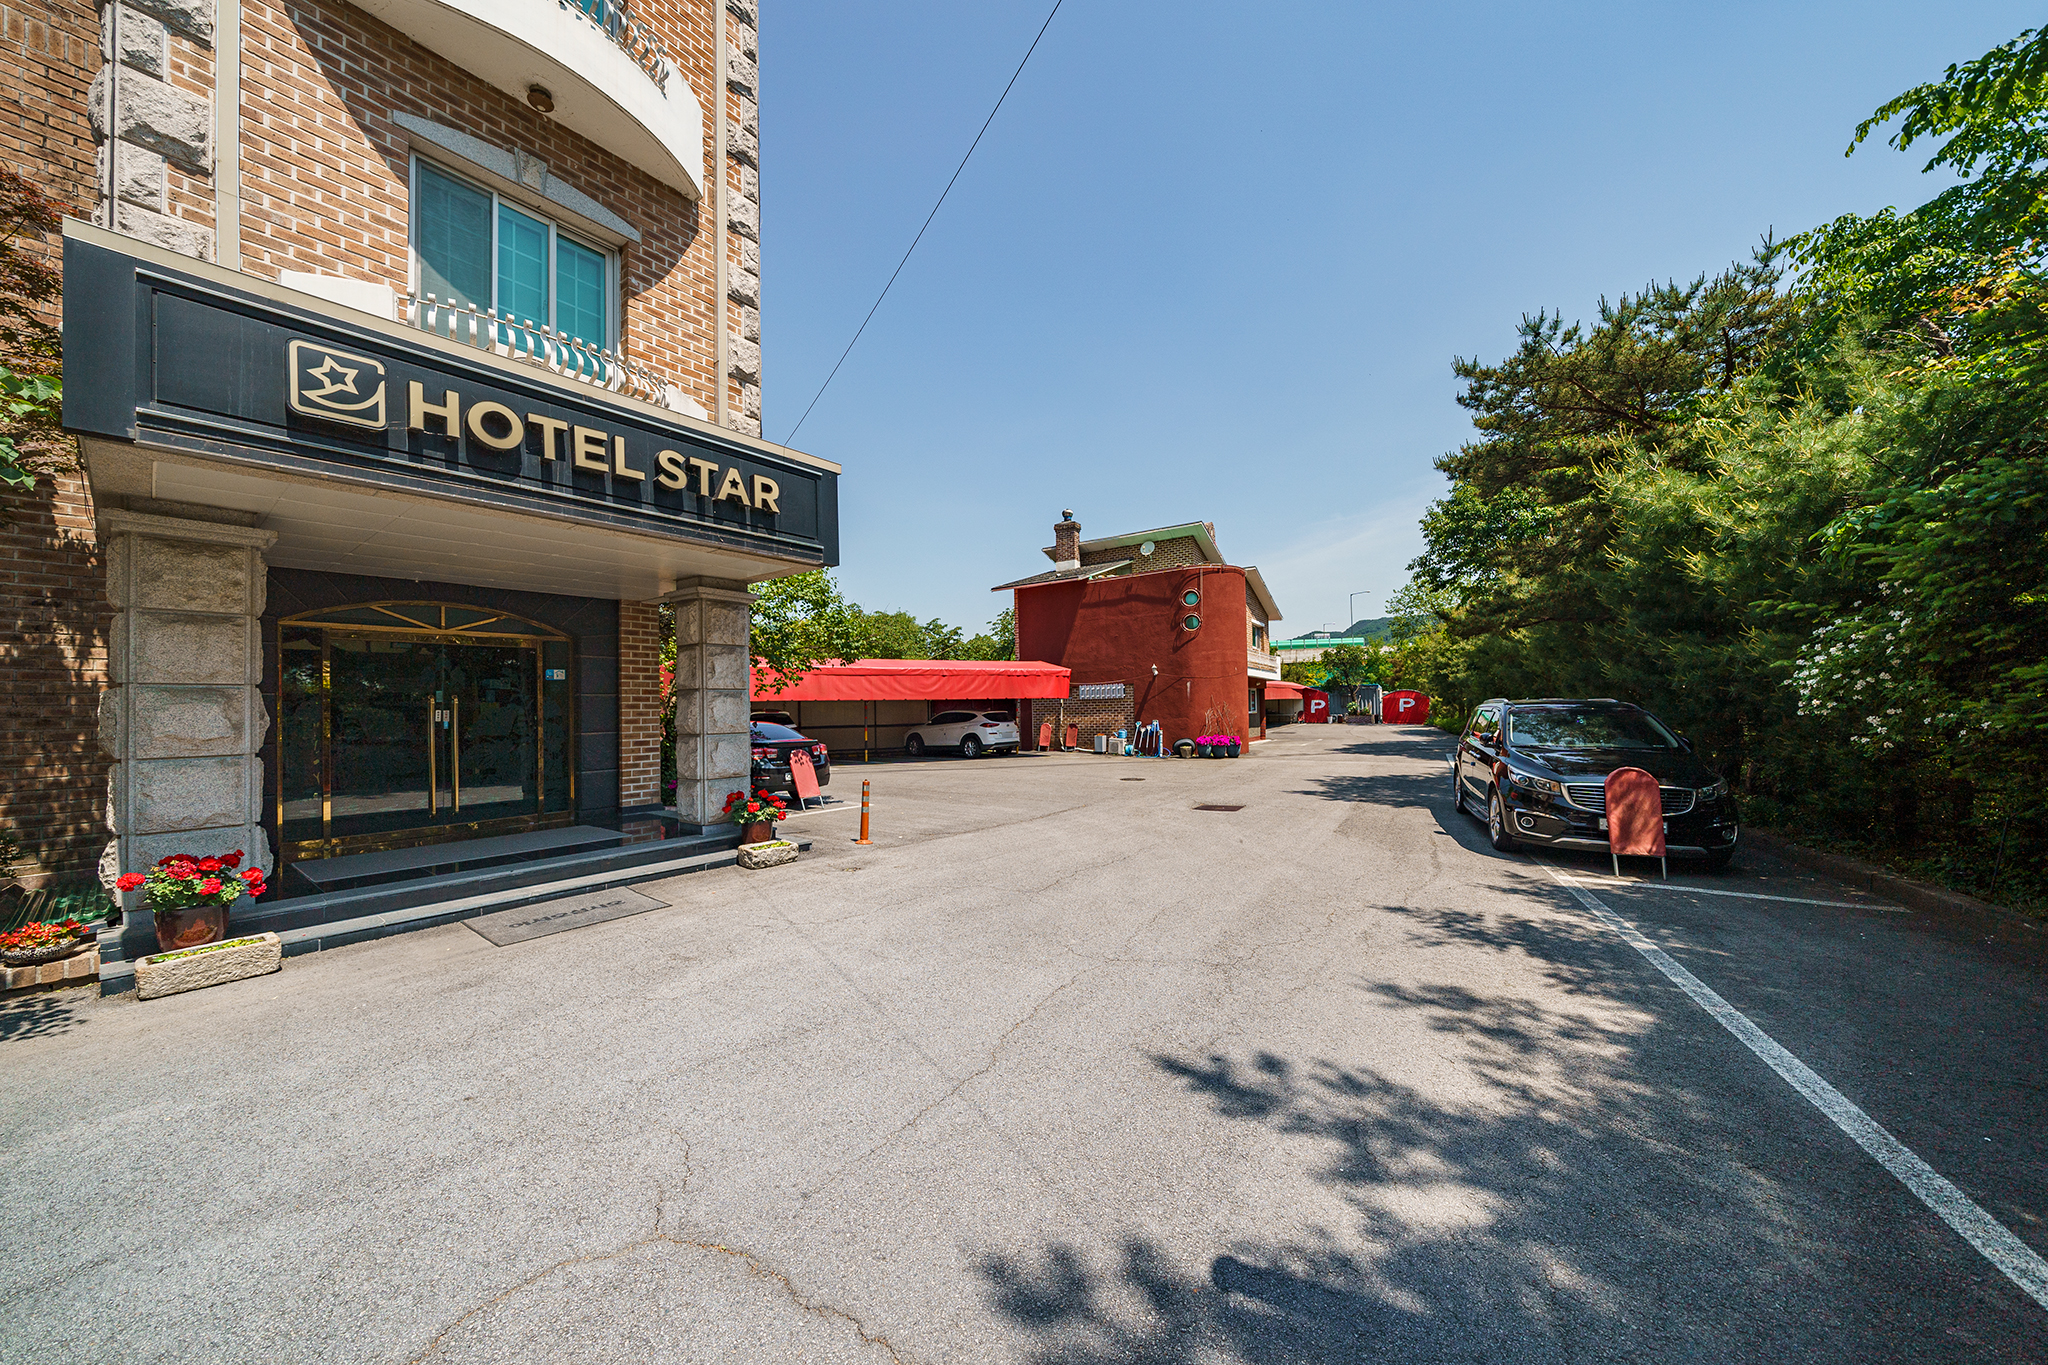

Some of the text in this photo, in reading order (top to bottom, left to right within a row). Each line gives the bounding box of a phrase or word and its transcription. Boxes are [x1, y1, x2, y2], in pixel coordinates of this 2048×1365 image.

[408, 380, 781, 514] HOTEL STAR
[1310, 699, 1326, 713] P
[1399, 698, 1415, 712] P
